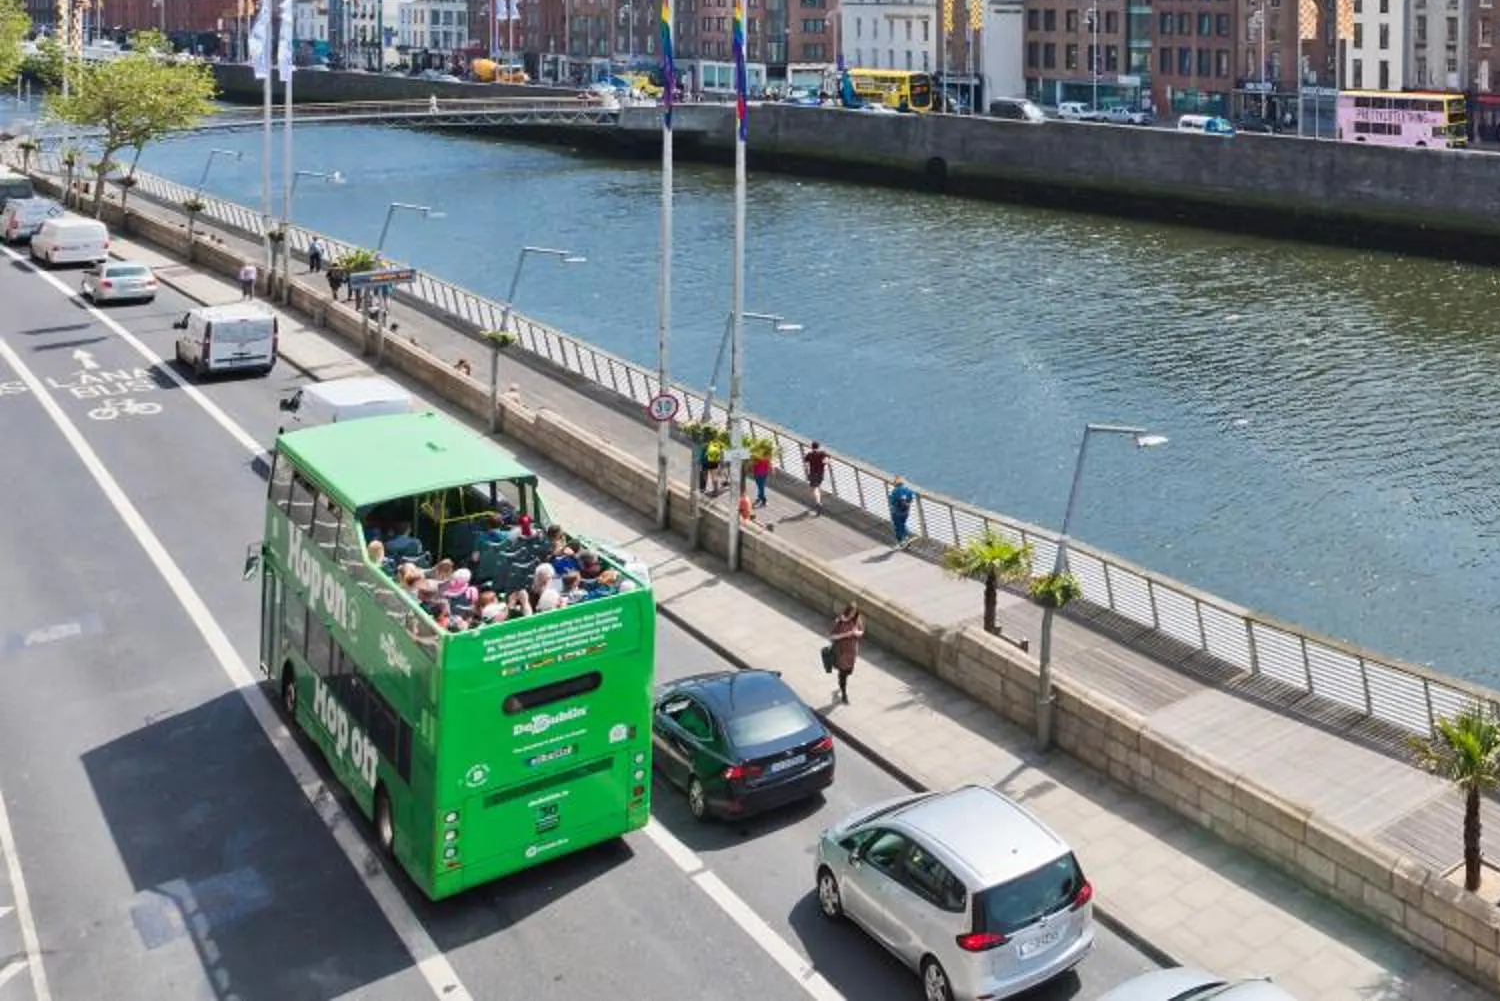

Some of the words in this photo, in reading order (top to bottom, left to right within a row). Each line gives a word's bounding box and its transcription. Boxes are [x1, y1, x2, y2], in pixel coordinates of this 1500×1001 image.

[287, 520, 321, 611] Hop
[323, 573, 347, 630] on
[313, 672, 349, 760] Hop
[351, 726, 378, 790] on
